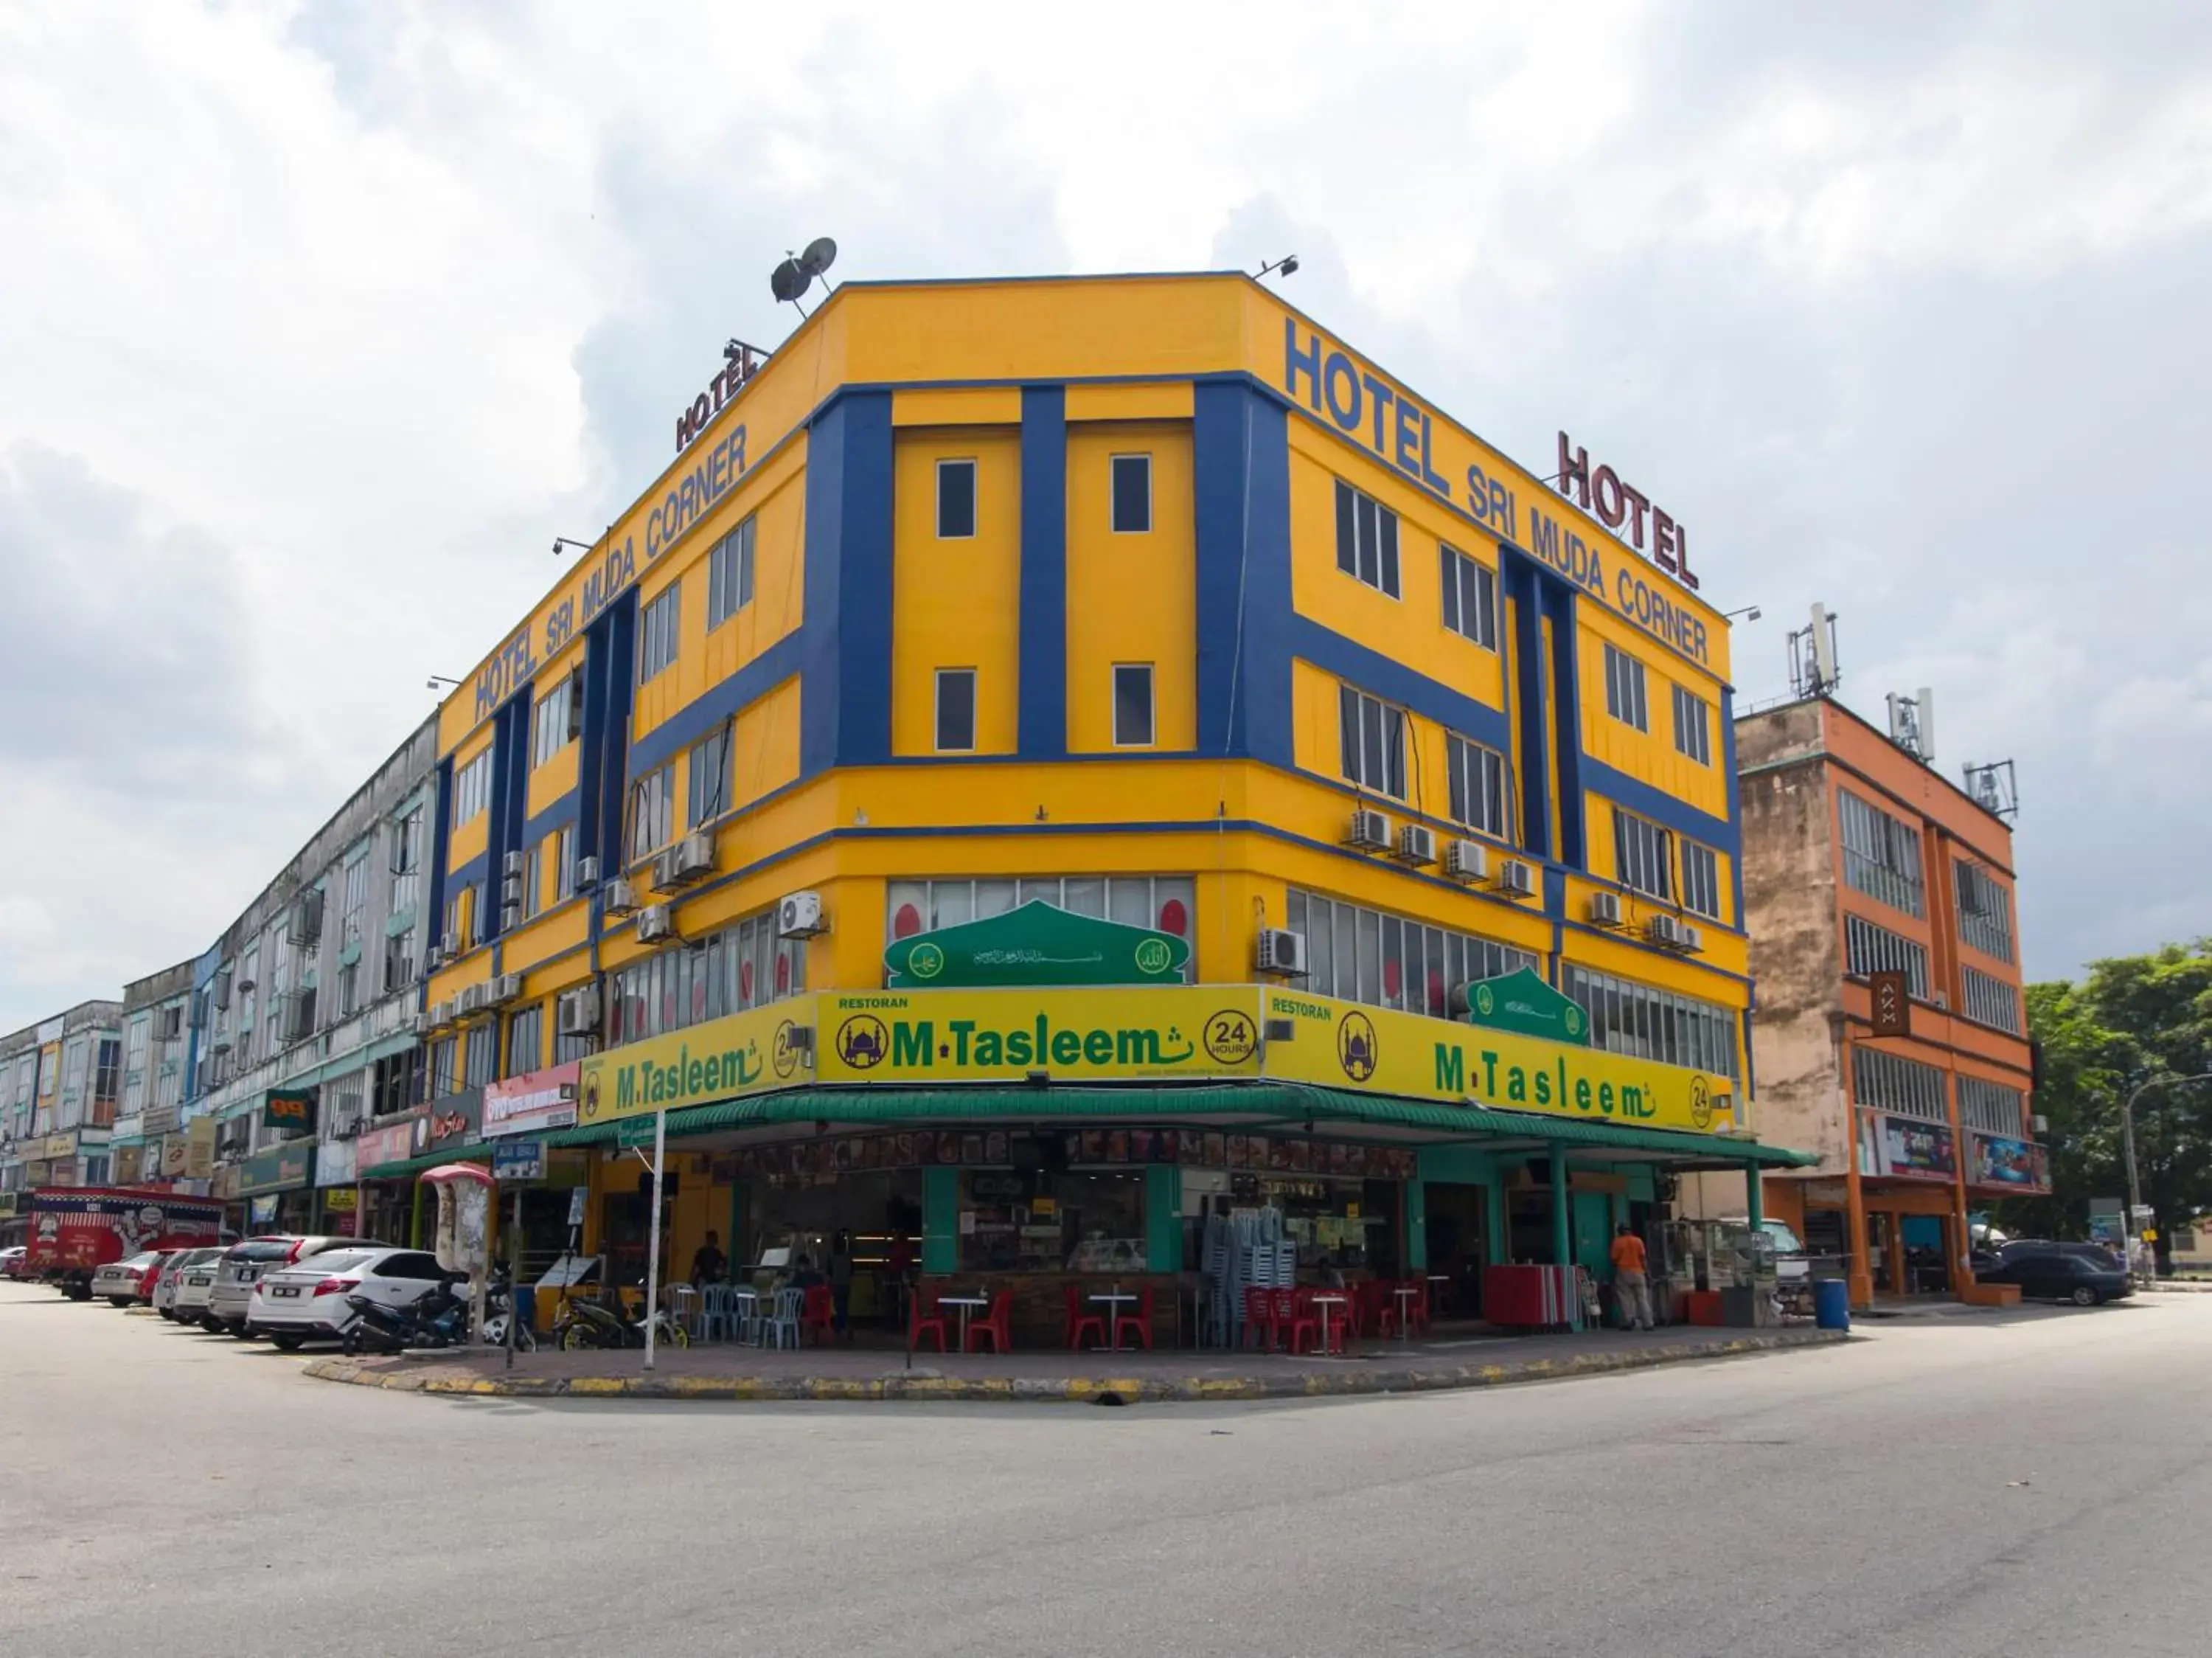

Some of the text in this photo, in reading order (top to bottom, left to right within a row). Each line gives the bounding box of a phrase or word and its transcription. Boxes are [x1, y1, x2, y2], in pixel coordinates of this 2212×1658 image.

[676, 347, 758, 453] HOTEL
[1285, 316, 1708, 665] HOTEL SRI MUDA CORNER
[1558, 430, 1699, 590] HOTEL
[475, 423, 747, 724] HOTEL SRI MUDA CORNER
[839, 997, 908, 1008] RESTORAN
[1273, 998, 1331, 1021] RESTORAN
[1215, 1021, 1247, 1044] 24
[1211, 1044, 1250, 1055] HOURS
[1694, 1086, 1707, 1107] 24
